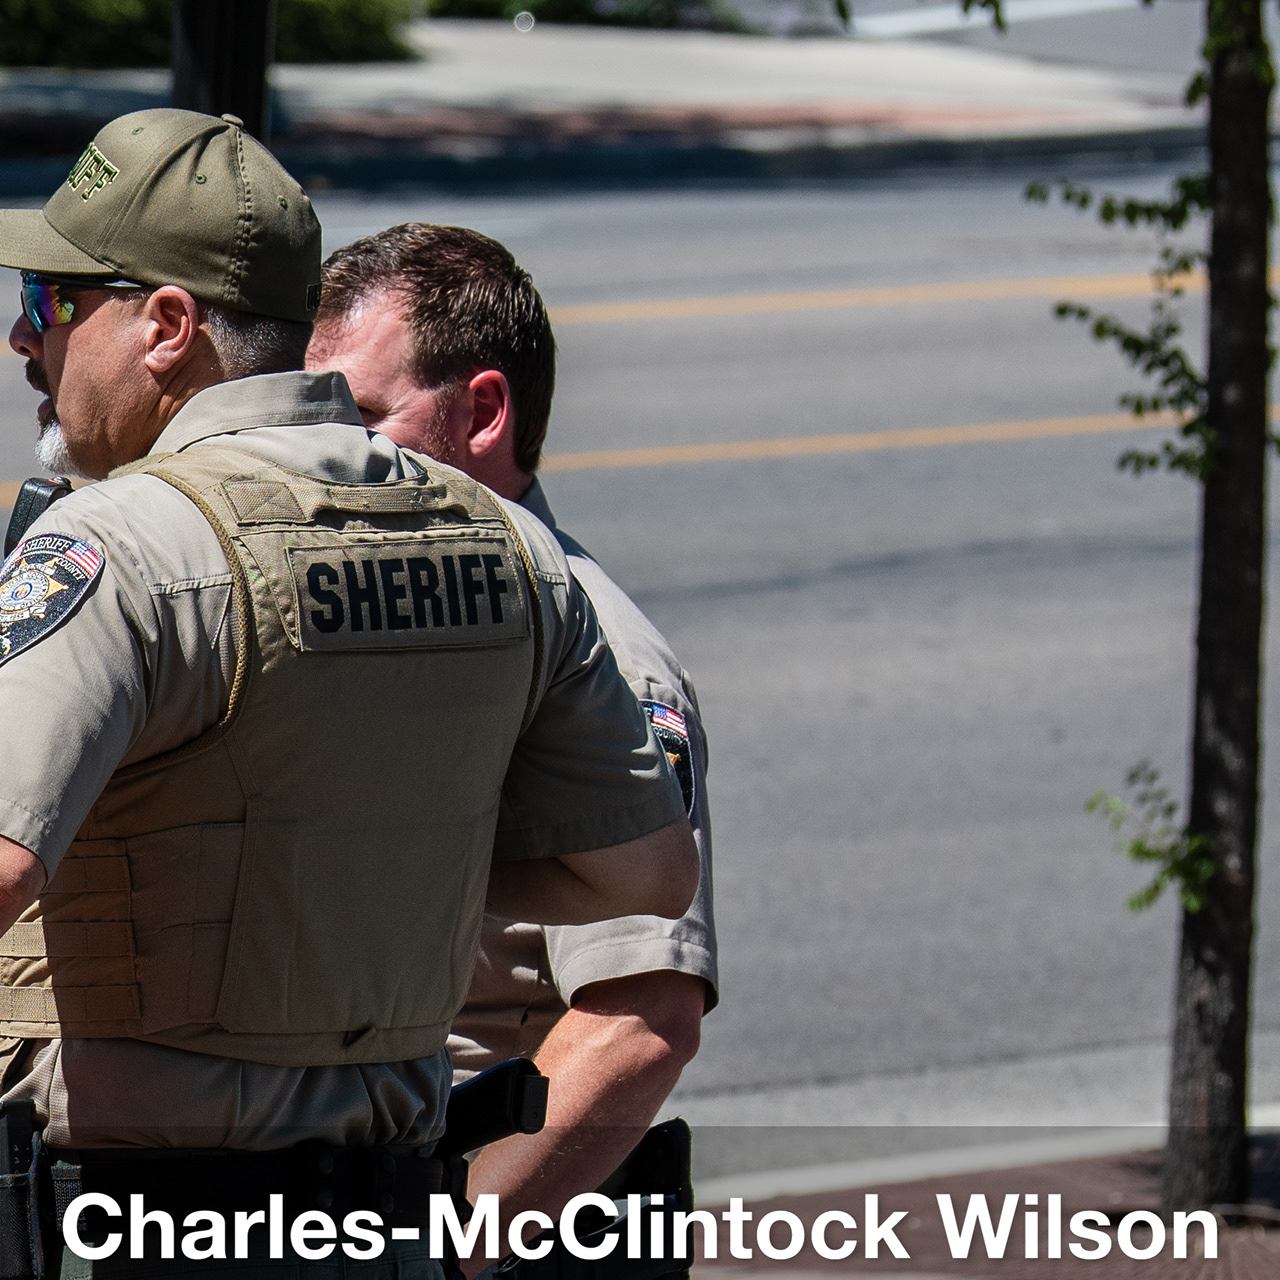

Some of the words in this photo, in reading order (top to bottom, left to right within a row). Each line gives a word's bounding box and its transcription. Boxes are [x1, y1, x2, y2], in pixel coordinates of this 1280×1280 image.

[24, 536, 73, 553] SHERIFF
[56, 558, 86, 581] COUNTY
[306, 554, 508, 634] SHERIFF
